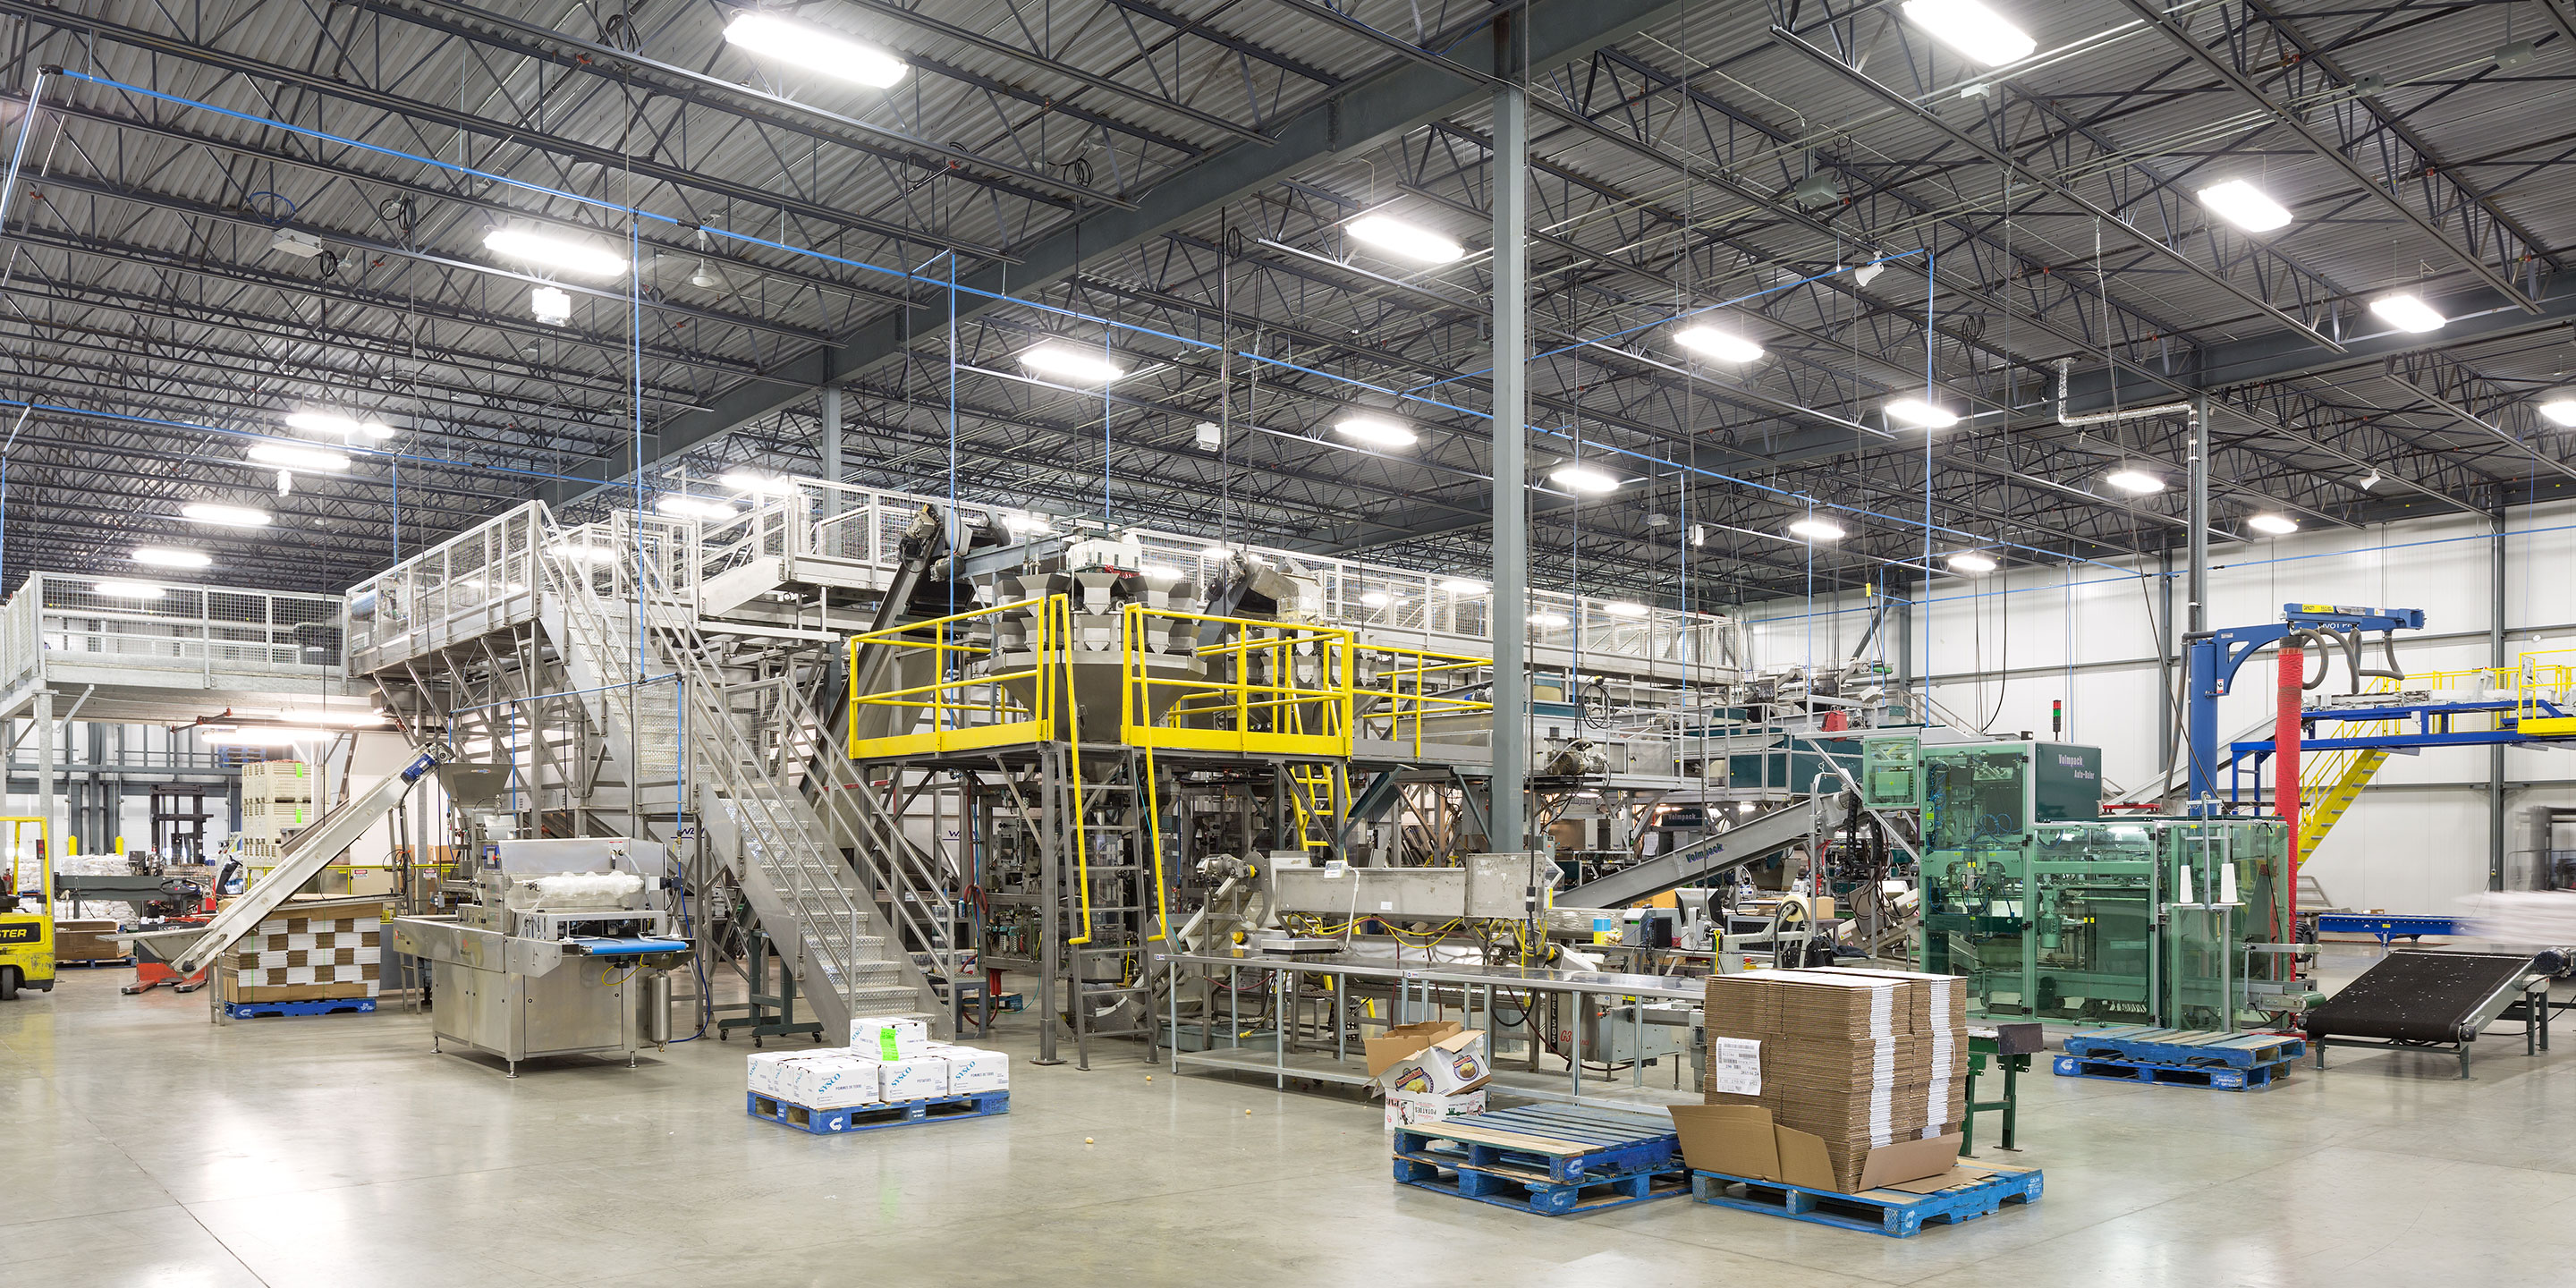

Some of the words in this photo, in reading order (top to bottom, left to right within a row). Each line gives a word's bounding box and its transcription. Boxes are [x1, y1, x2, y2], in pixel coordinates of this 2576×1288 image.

[2058, 754, 2083, 767] Volmpack
[1668, 813, 1697, 821] Volmpack
[891, 1066, 911, 1088] SYSCO
[955, 1061, 976, 1080] SYSCO
[818, 1072, 841, 1094] SYSCO
[1415, 1106, 1436, 1115] POTATOES
